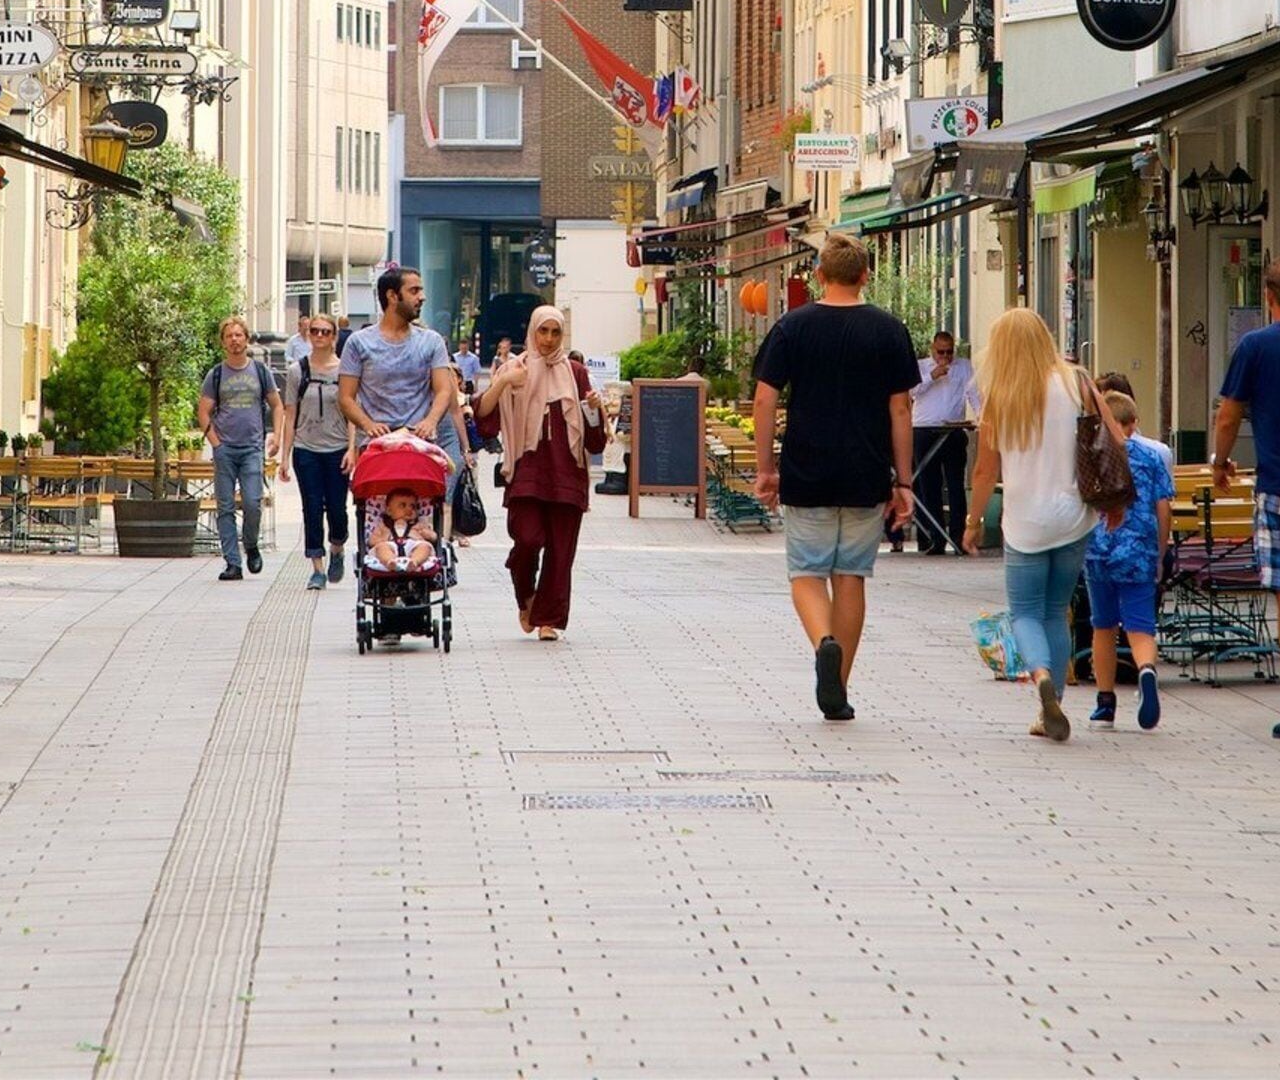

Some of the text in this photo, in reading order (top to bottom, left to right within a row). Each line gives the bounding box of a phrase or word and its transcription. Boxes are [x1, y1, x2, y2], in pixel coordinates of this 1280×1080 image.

[80, 53, 182, 69] Tante Anna
[798, 139, 849, 147] RISTORANTE
